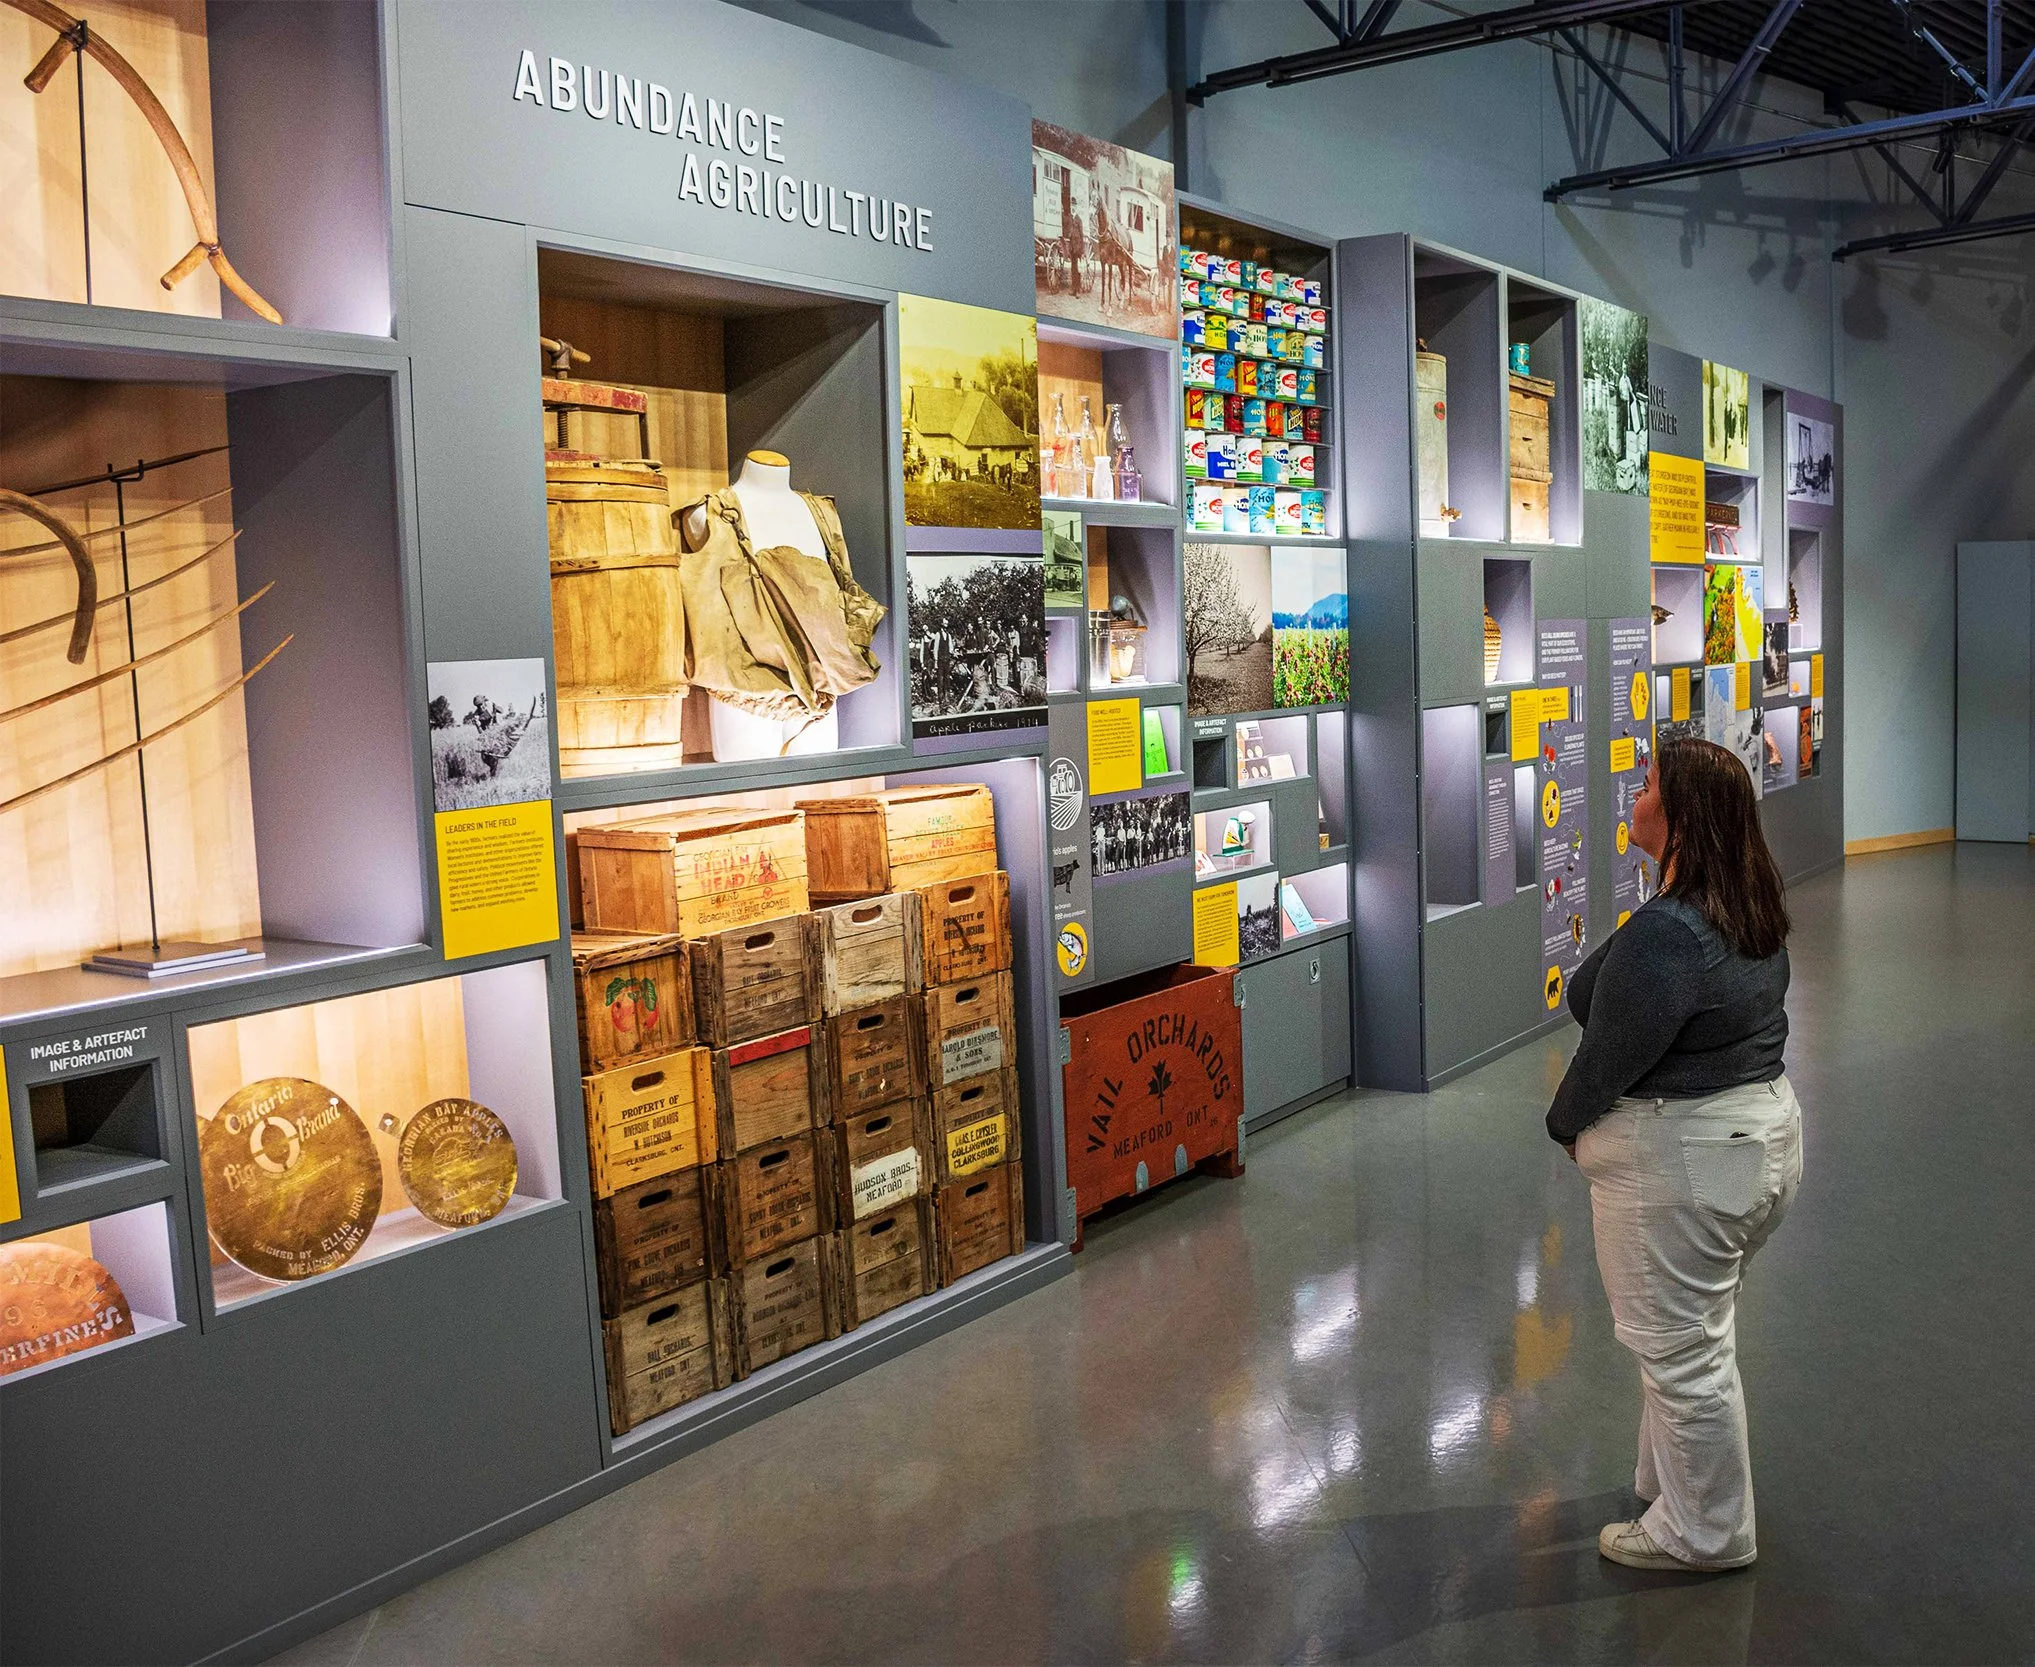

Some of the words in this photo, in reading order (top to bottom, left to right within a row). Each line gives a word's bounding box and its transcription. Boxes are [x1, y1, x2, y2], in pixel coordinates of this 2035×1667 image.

[514, 49, 785, 163] ABUNDANCE
[678, 152, 934, 251] AGRICULTURE
[445, 822, 475, 834] LEADERS
[477, 821, 483, 830] IN
[485, 819, 497, 829] THE
[498, 817, 517, 827] FIELD
[694, 854, 750, 880] INDIAN
[700, 873, 746, 894] HEAD
[30, 1040, 71, 1060] IMAGE
[72, 1039, 83, 1051] &
[84, 1026, 148, 1050] ARTEFACT
[1127, 1012, 1231, 1101] ORCHARDS
[50, 1045, 133, 1073] INFORMATION
[224, 1084, 294, 1136] Ontario
[621, 1098, 666, 1120] PROPERTY
[668, 1094, 680, 1106] OF
[1086, 1077, 1123, 1153] VAIL
[402, 1111, 433, 1173] GEORGIAN
[463, 1105, 504, 1139] APPLES
[951, 1134, 1000, 1159] COLLINGWOOD
[1112, 1120, 1173, 1160] MEAFORD
[1186, 1104, 1208, 1128] ONT
[953, 1144, 1000, 1169] CLARKSBURG
[223, 1162, 259, 1193] Big
[866, 1178, 903, 1203] MEAFORD
[321, 1220, 352, 1252] ELLIS
